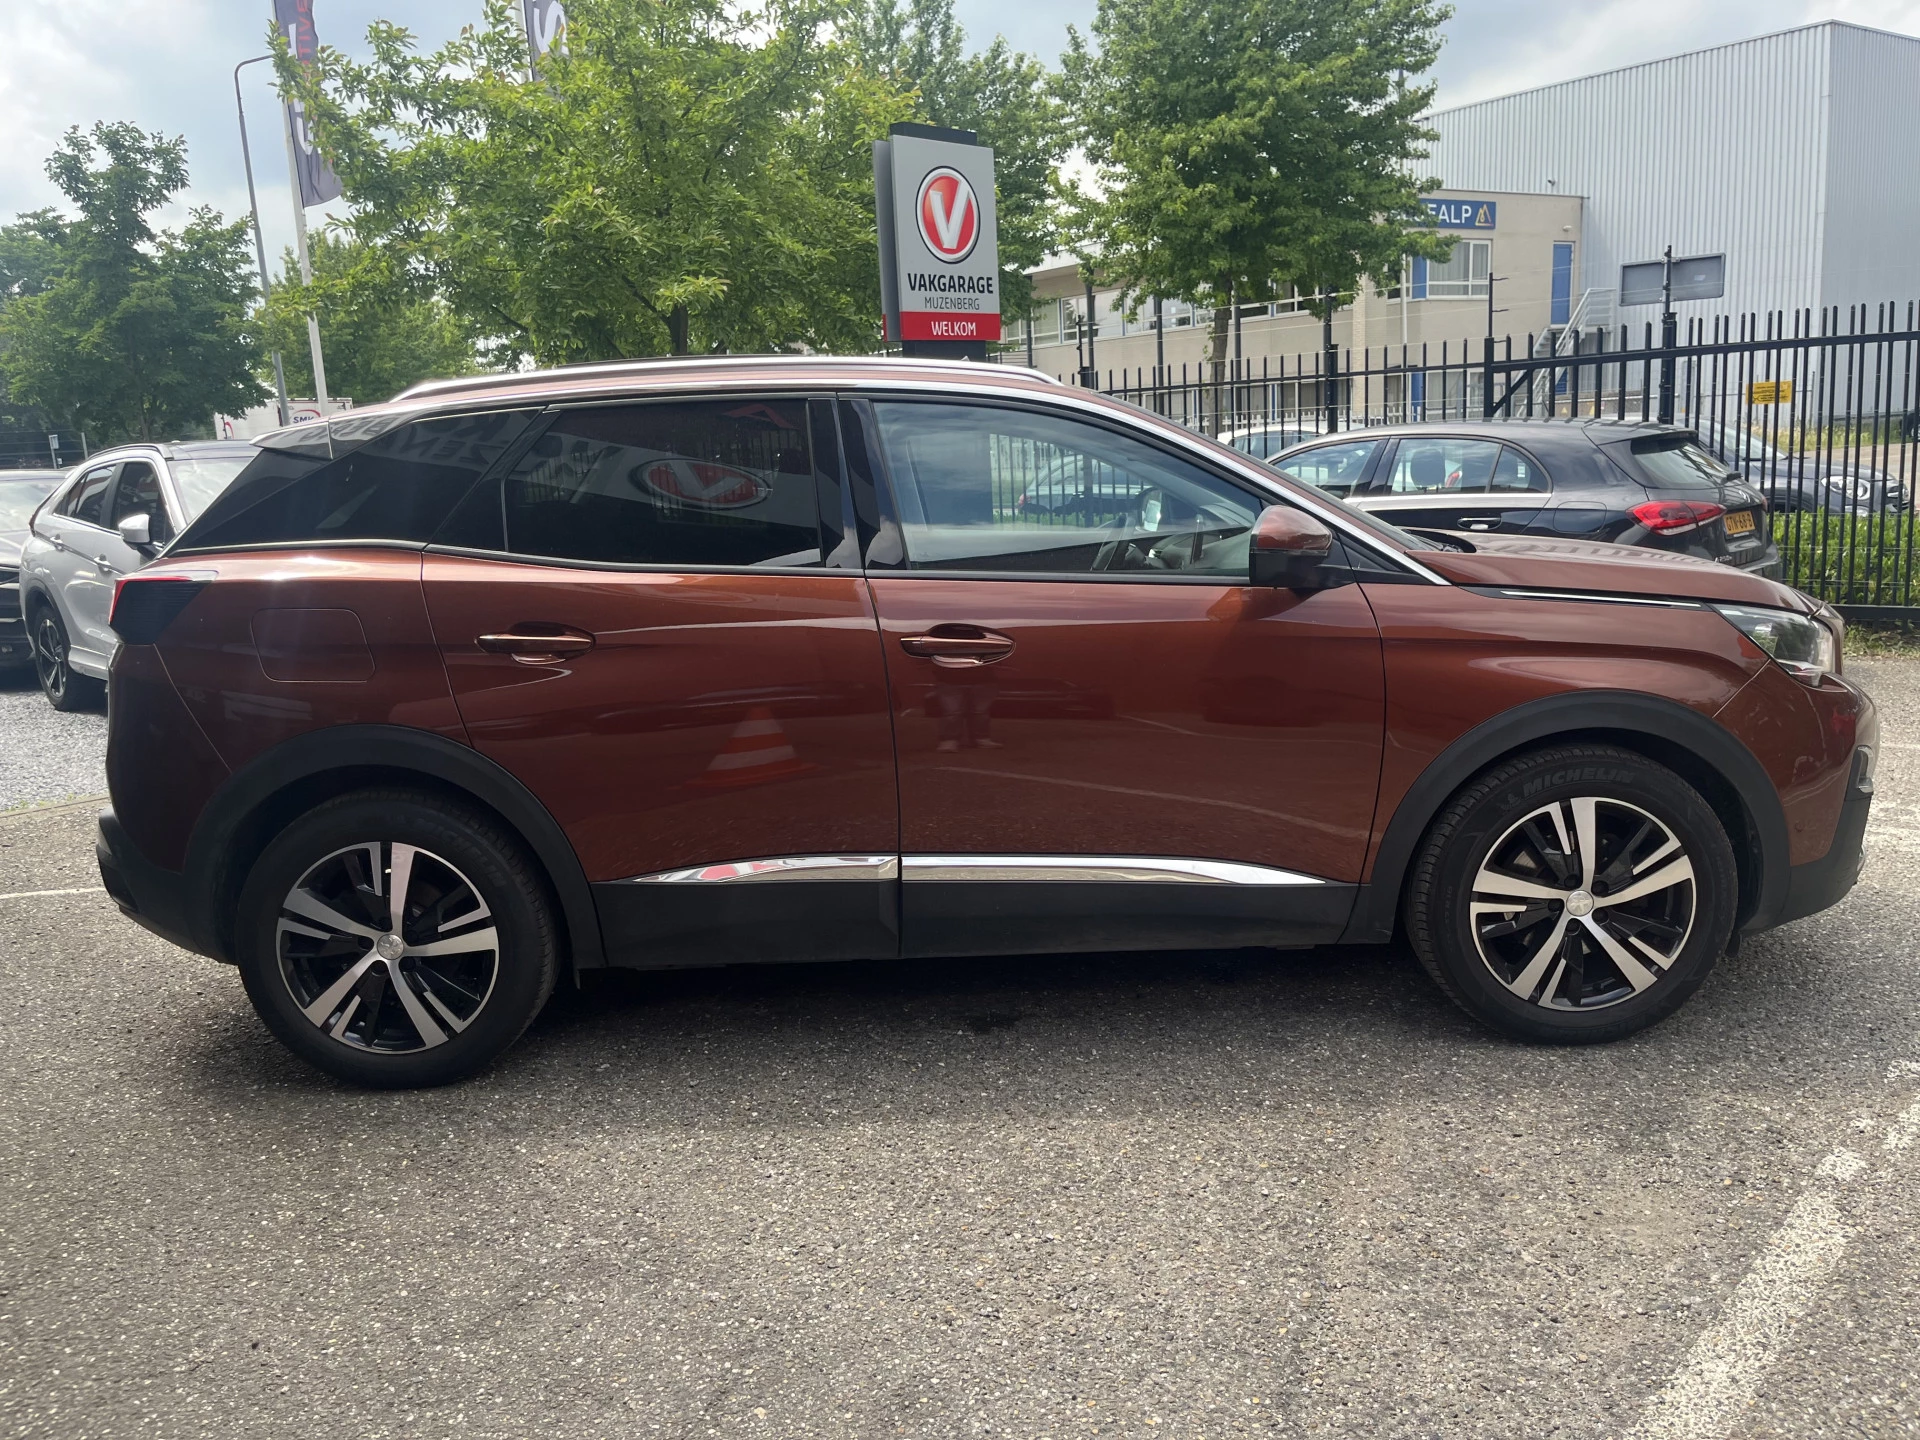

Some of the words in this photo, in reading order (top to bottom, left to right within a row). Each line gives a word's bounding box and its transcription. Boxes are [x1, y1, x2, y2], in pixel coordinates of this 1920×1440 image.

[907, 272, 994, 294] VAKGARAGE
[924, 296, 980, 311] MUZENBERG
[931, 320, 977, 337] WELKOM
[1522, 767, 1637, 797] MICHELIN
